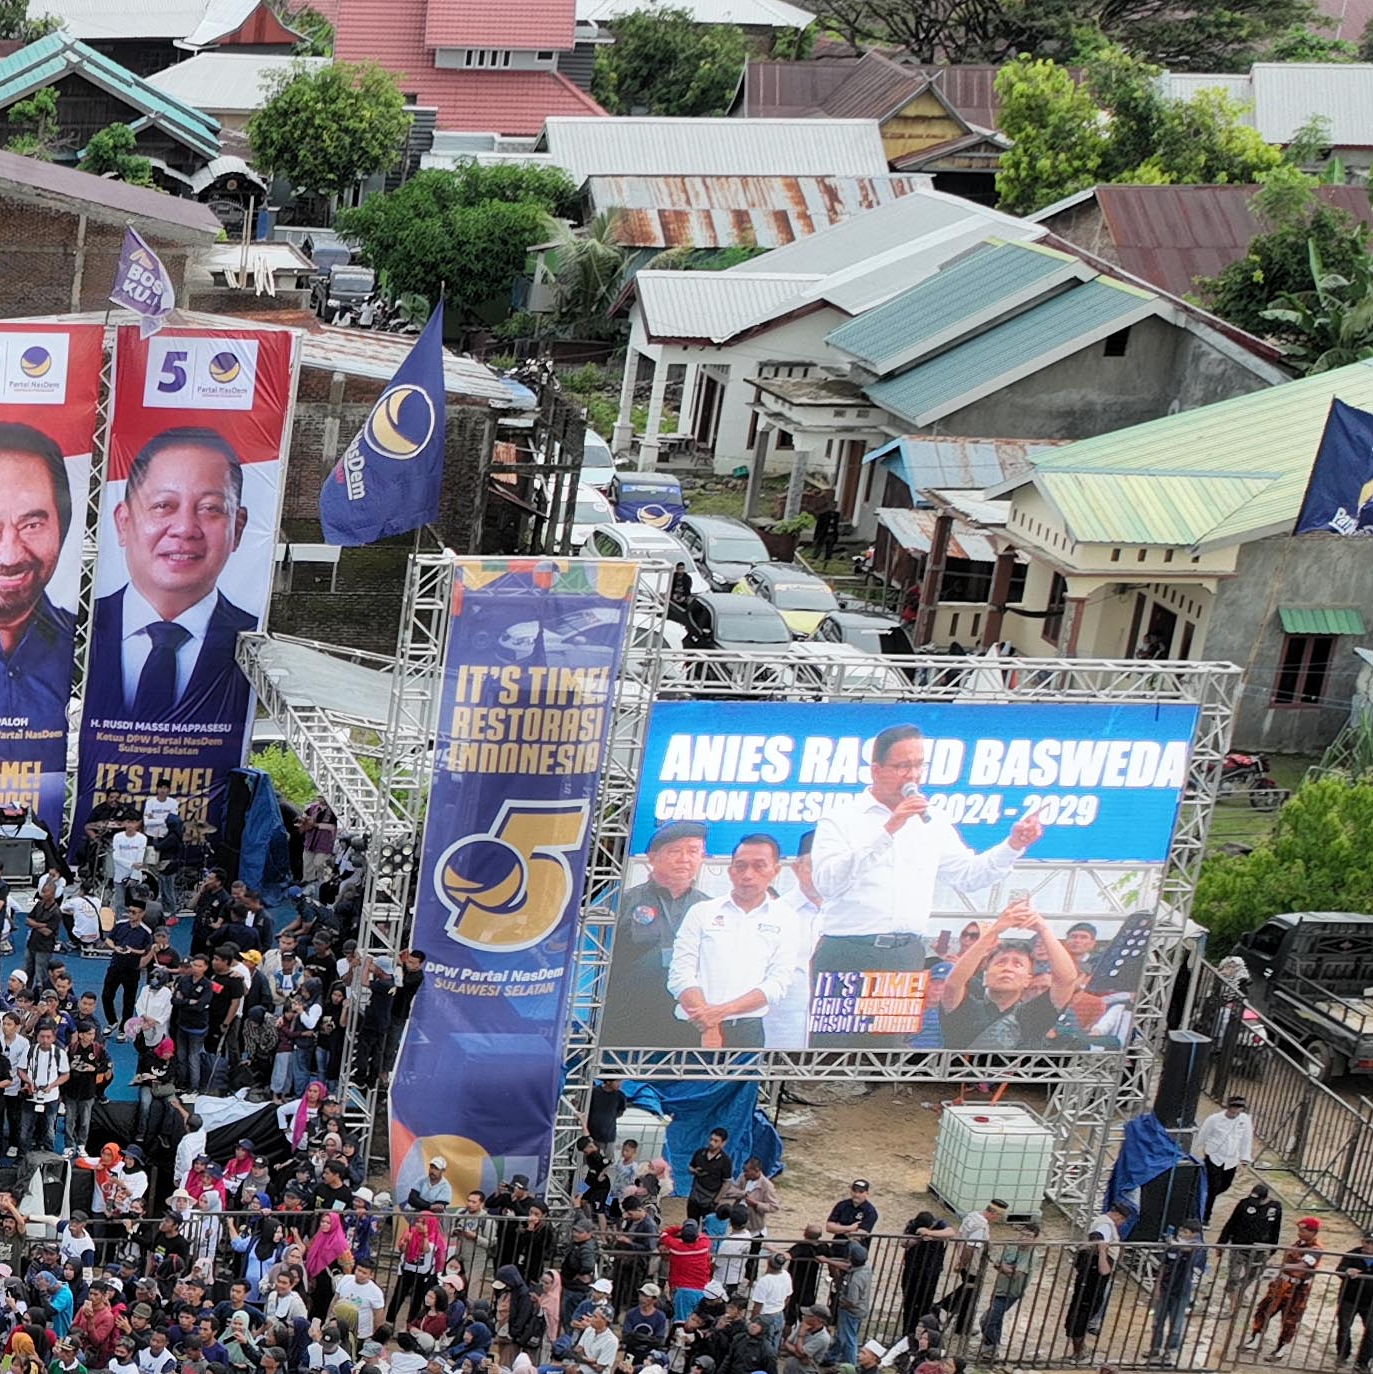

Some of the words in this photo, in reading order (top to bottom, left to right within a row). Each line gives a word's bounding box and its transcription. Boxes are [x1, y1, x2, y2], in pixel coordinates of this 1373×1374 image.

[157, 351, 189, 393] 5
[455, 664, 521, 705] IT'S
[528, 665, 610, 706] TIME!
[24, 729, 63, 740] NasDem
[90, 718, 100, 729] H.
[102, 719, 133, 731] RUSDI
[134, 720, 170, 733] MASSE
[171, 721, 232, 734] MAPPASESU
[96, 732, 124, 744] Ketua
[126, 733, 151, 745] DPW
[152, 734, 182, 746] Partai
[183, 735, 224, 747] NasDem
[450, 706, 605, 742] RESTORASI
[117, 743, 159, 755] Sulawesi
[160, 745, 199, 756] Selatan
[447, 741, 602, 776] INDONESIA
[658, 733, 792, 784] ANIES
[94, 762, 143, 794] IT'S
[653, 788, 749, 823] CALON
[424, 961, 459, 979] DPW
[460, 967, 509, 983] Partai
[510, 966, 565, 984] NasDem
[434, 977, 501, 998] SULAWESI
[503, 981, 555, 997] SELATAN
